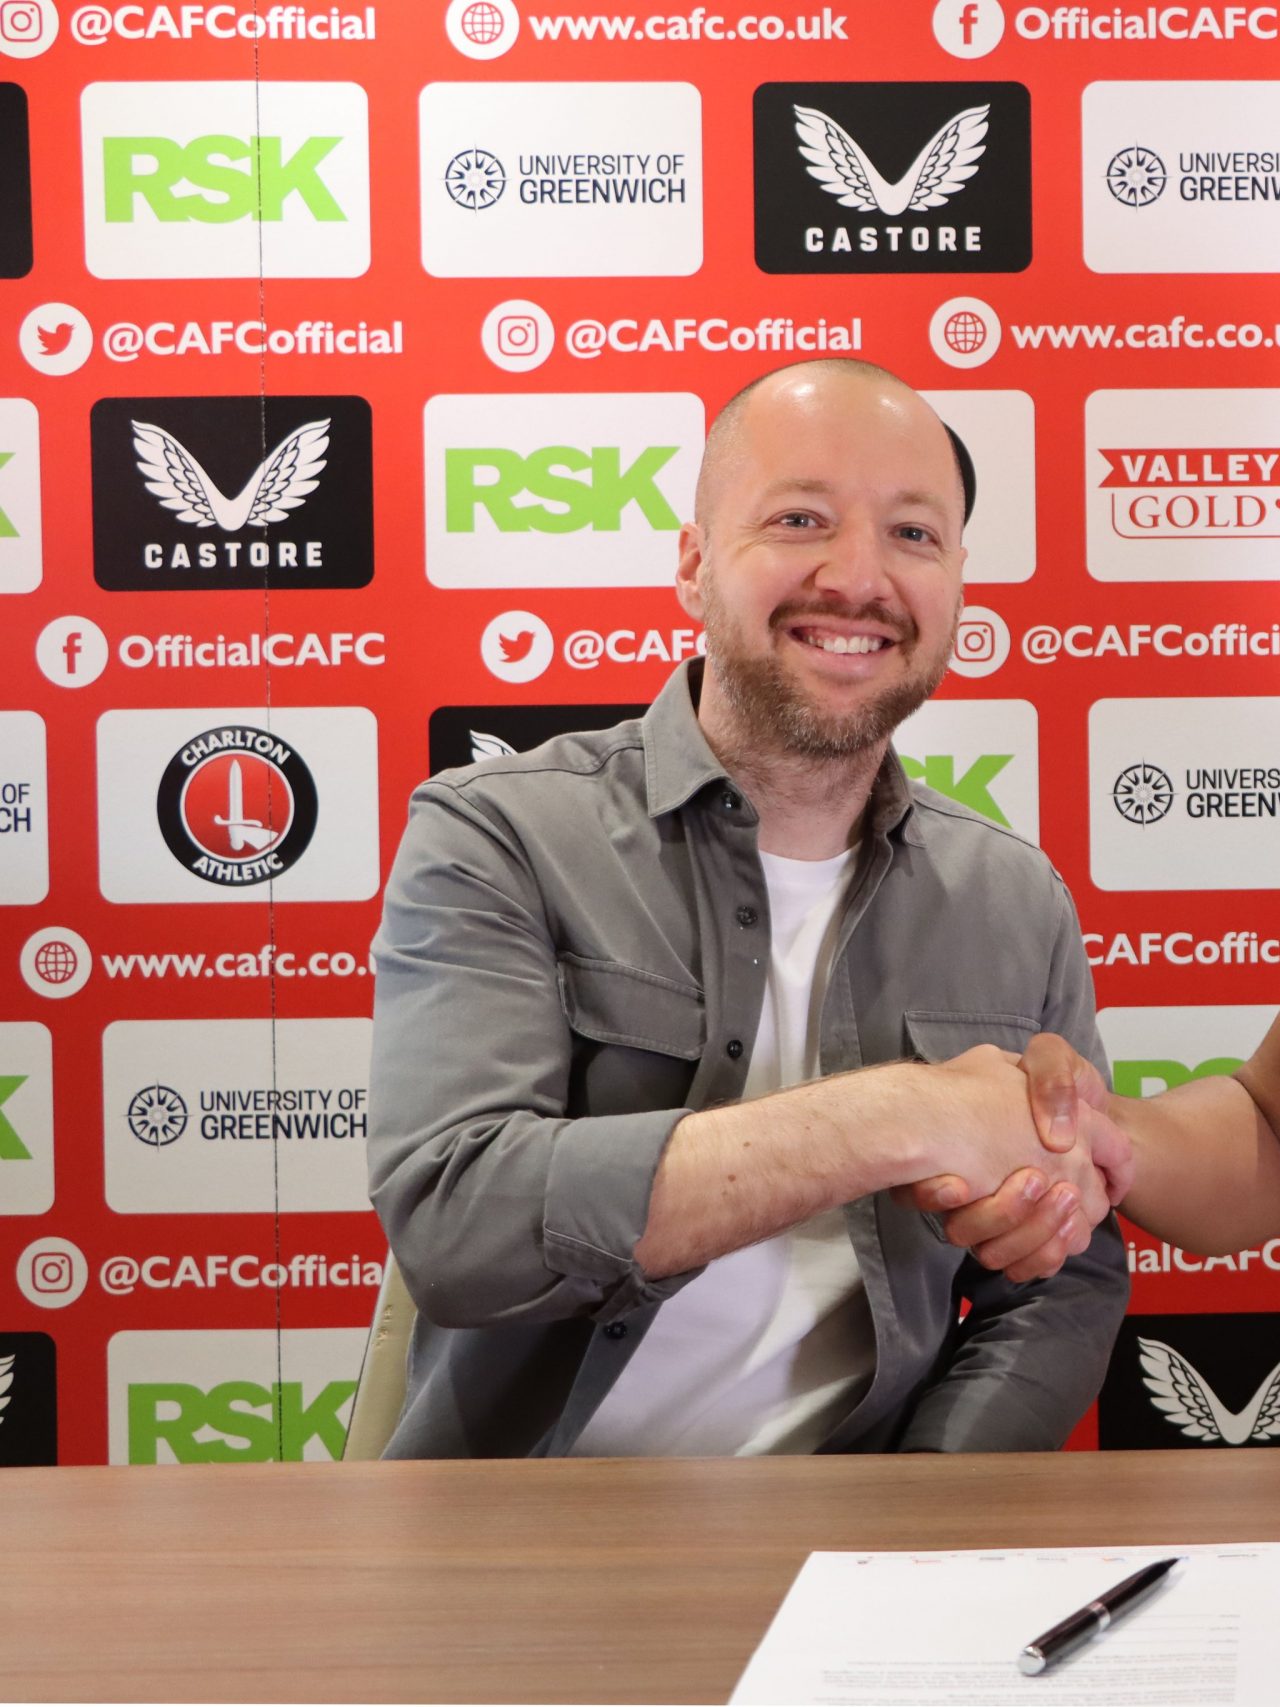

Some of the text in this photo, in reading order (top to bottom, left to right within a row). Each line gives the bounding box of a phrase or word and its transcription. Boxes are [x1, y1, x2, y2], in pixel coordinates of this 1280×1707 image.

[70, 5, 377, 46] @CAFCofficial
[529, 6, 848, 42] www.cafc.co.uk
[1015, 5, 1278, 41] OfficialCAFC
[103, 135, 348, 224] RSK
[519, 155, 685, 175] UNIVERSITY OF
[519, 179, 686, 204] GREENWICH
[805, 226, 982, 252] CASTORE
[103, 321, 403, 362] @CAFCofficial
[566, 318, 862, 360] @CAFCofficial
[1122, 455, 1280, 483] VALLEY
[444, 445, 682, 533] RSK
[1129, 494, 1267, 529] GOLD
[145, 541, 323, 568] CASTORE
[119, 633, 385, 668] OfficialCAFC
[181, 729, 290, 766] CHARLTON
[2, 783, 30, 805] OF
[193, 852, 283, 882] ATHLETIC
[200, 1089, 366, 1112] UNIVERSITY OF
[200, 1113, 367, 1140] GREENWICH
[128, 1381, 358, 1464] RSK
